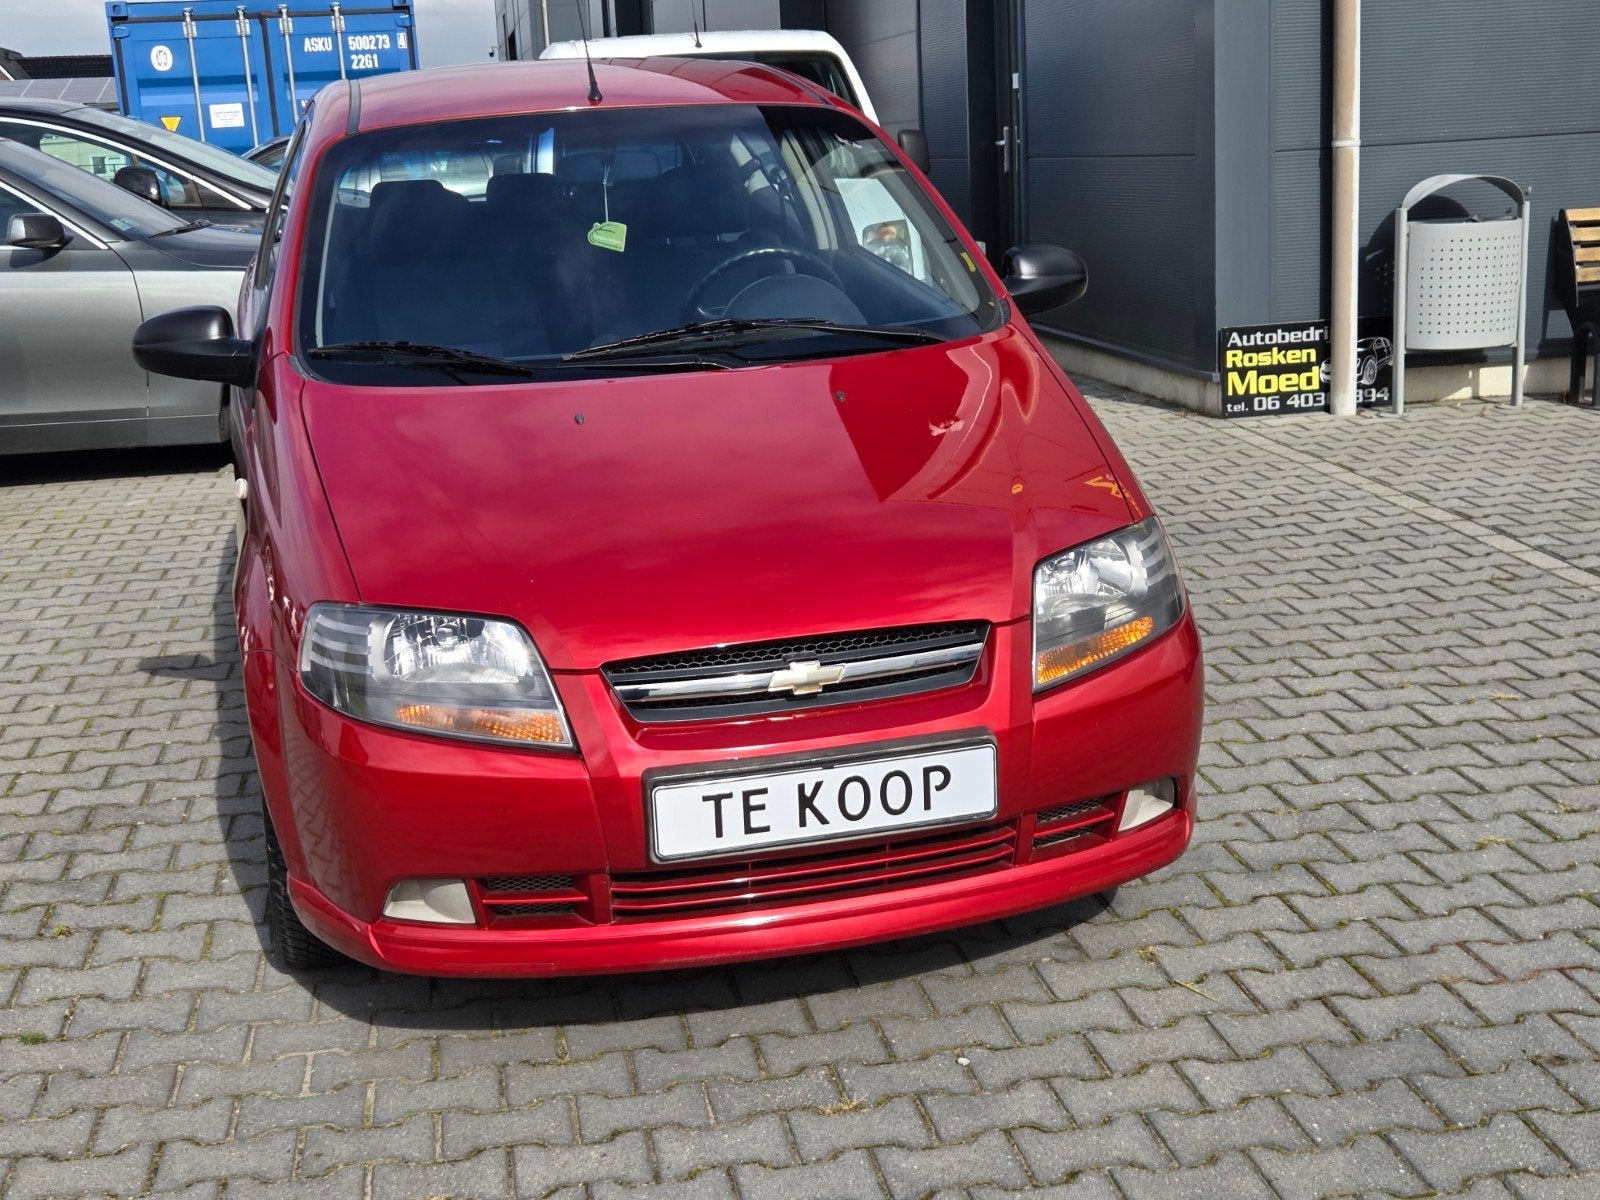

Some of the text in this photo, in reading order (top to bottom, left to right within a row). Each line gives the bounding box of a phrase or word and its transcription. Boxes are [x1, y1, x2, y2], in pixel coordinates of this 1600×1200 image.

[304, 36, 333, 52] ASKU
[347, 34, 391, 51] 500273
[350, 53, 379, 69] 22G1
[1227, 326, 1331, 347] Autobedri
[1226, 347, 1317, 368] Rosken
[1227, 366, 1320, 396] Moed
[1226, 401, 1249, 412] tel.
[1253, 395, 1281, 411] 06
[701, 764, 952, 839] TE KOOP
